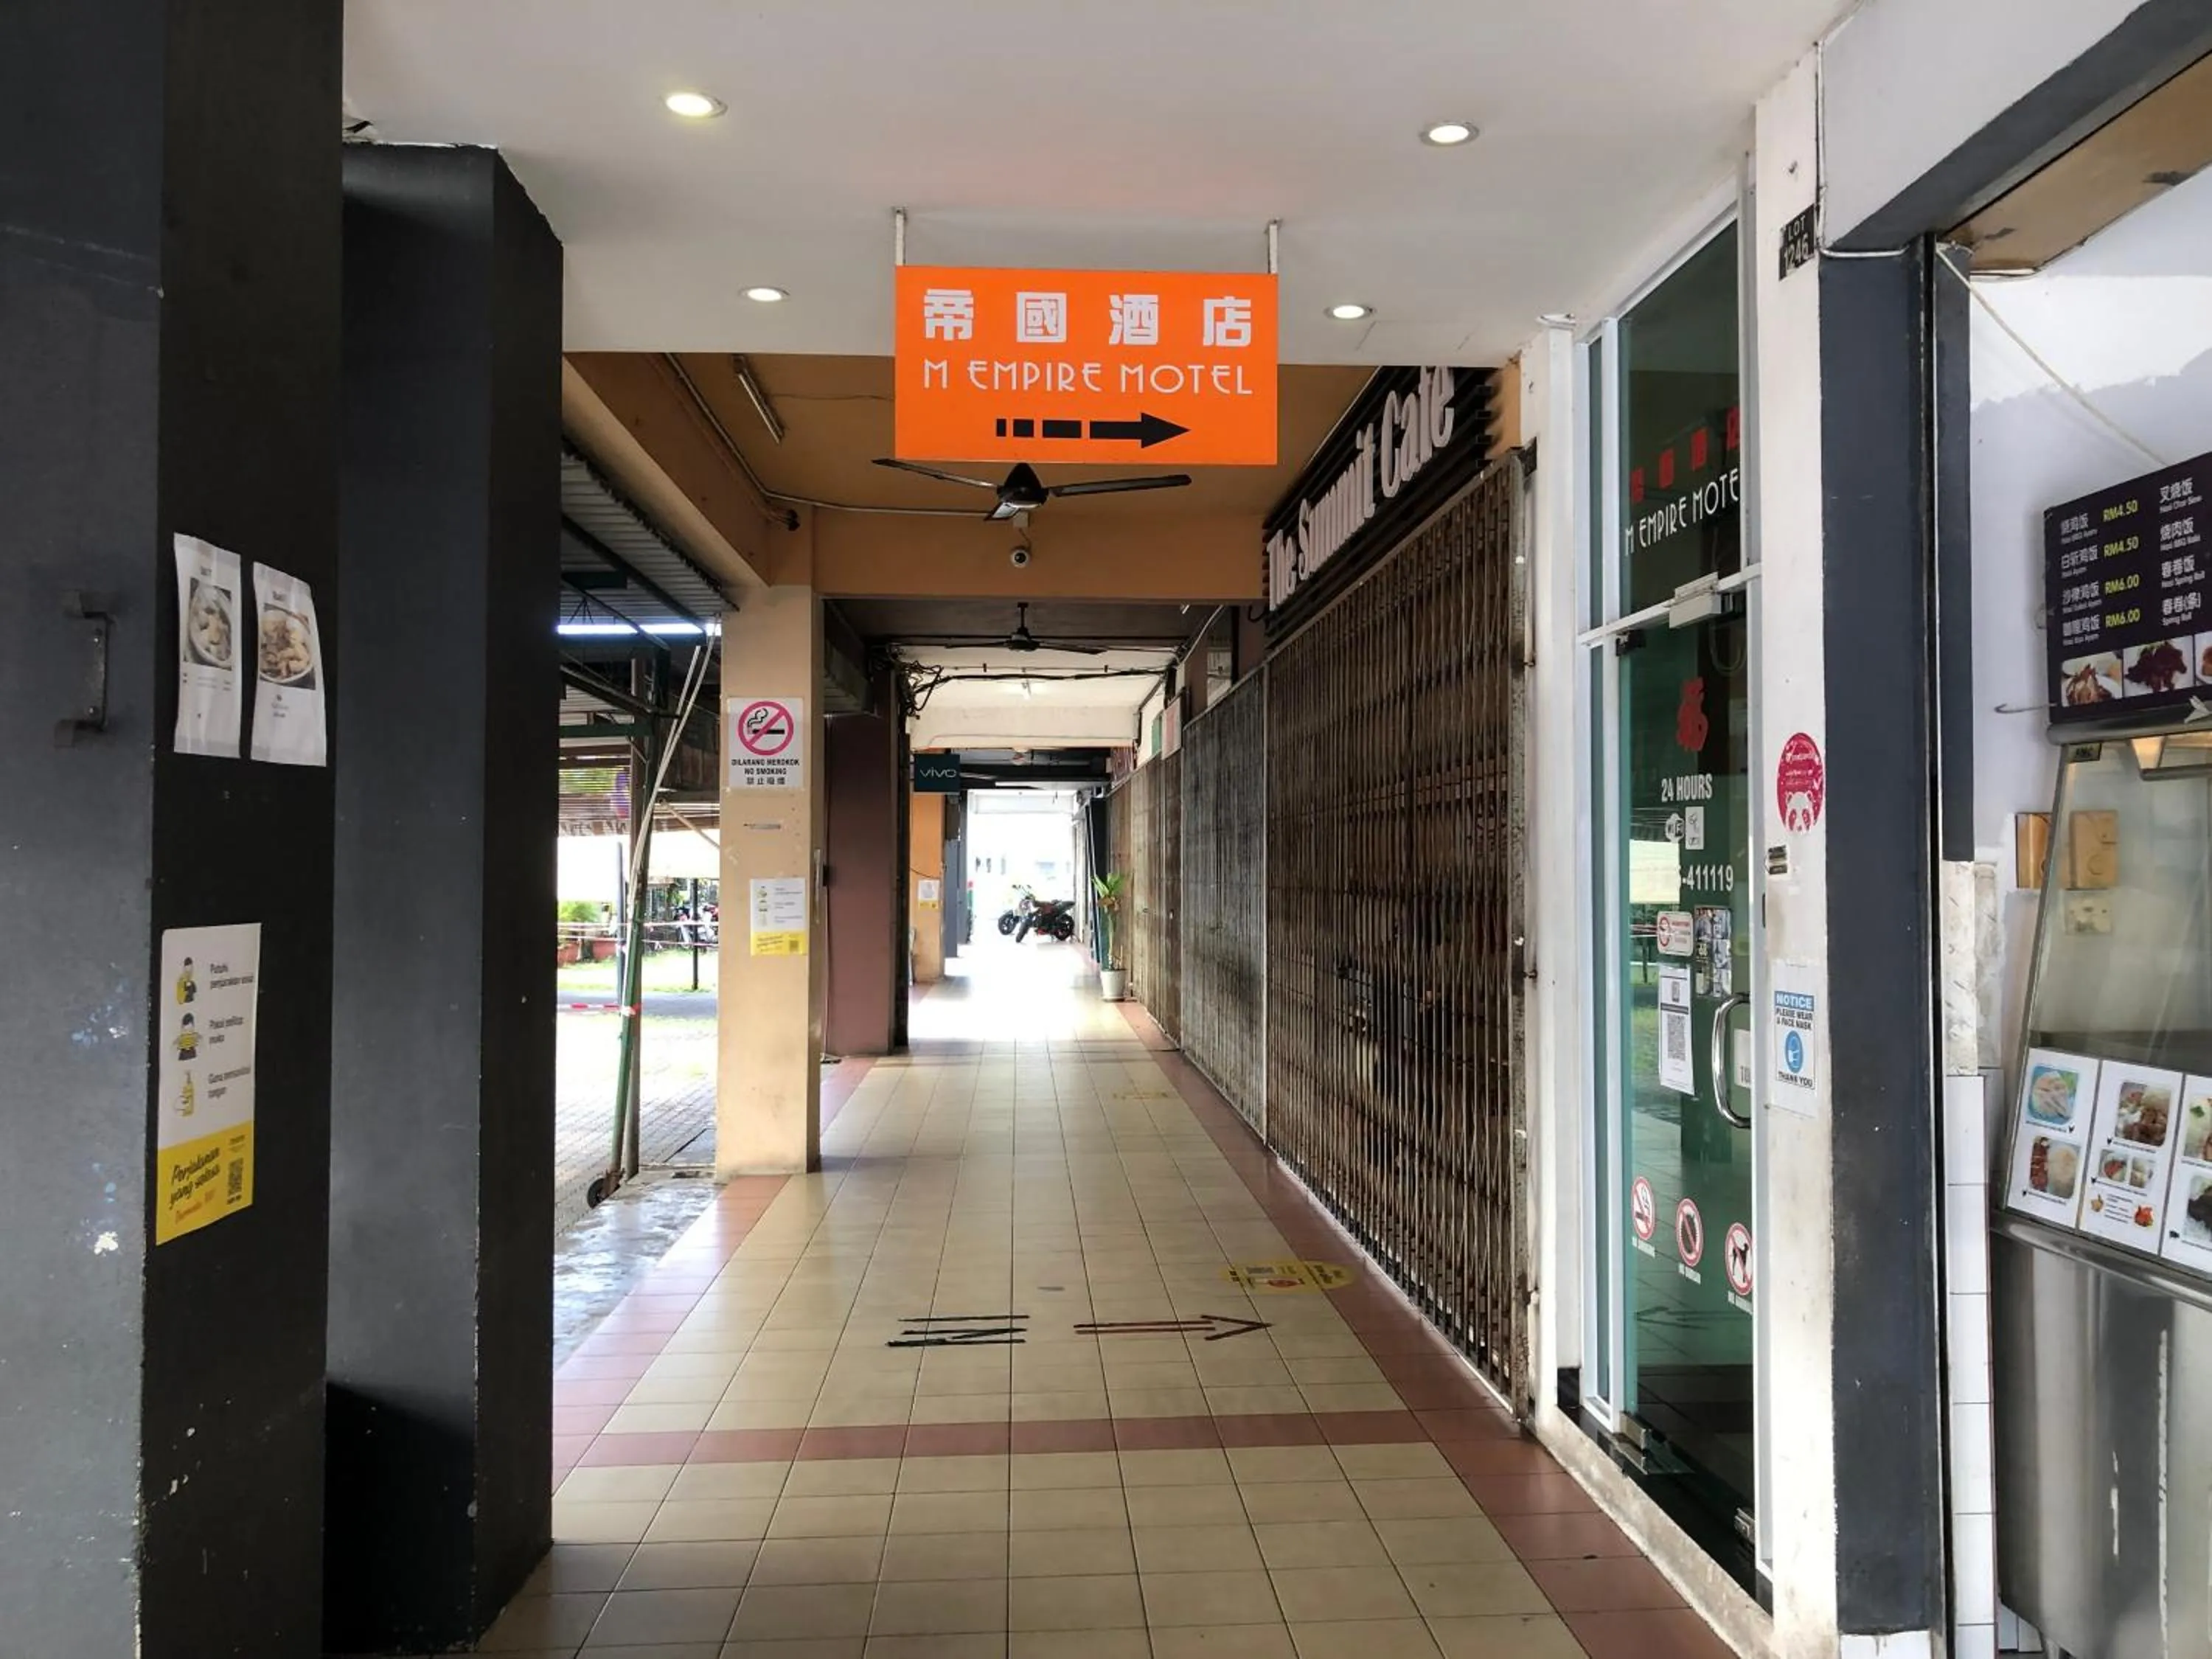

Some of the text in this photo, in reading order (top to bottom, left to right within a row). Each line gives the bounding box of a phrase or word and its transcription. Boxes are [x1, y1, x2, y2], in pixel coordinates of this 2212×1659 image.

[1788, 215, 1806, 241] LOT
[924, 288, 1251, 347] 帝國酒店
[924, 359, 1253, 395] M EMPIRE MOTEL
[1380, 365, 1455, 498] Cafe
[1625, 467, 1739, 557] M EMPIRE MOTE
[2103, 500, 2138, 522] RM4.50
[2104, 536, 2139, 558] RM4.50
[2105, 574, 2140, 595] RM6.00
[2105, 608, 2140, 628] RM6.00
[920, 766, 957, 779] vivo
[1661, 773, 1713, 802] 24 HOURS
[1678, 863, 1733, 891] -411119
[1775, 993, 1812, 1009] NOTICE
[1775, 1008, 1813, 1021] PLEASE WEAR
[1781, 1018, 1795, 1028] FACE
[1796, 1020, 1812, 1030] MASK
[1778, 1071, 1813, 1088] THANK YOU
